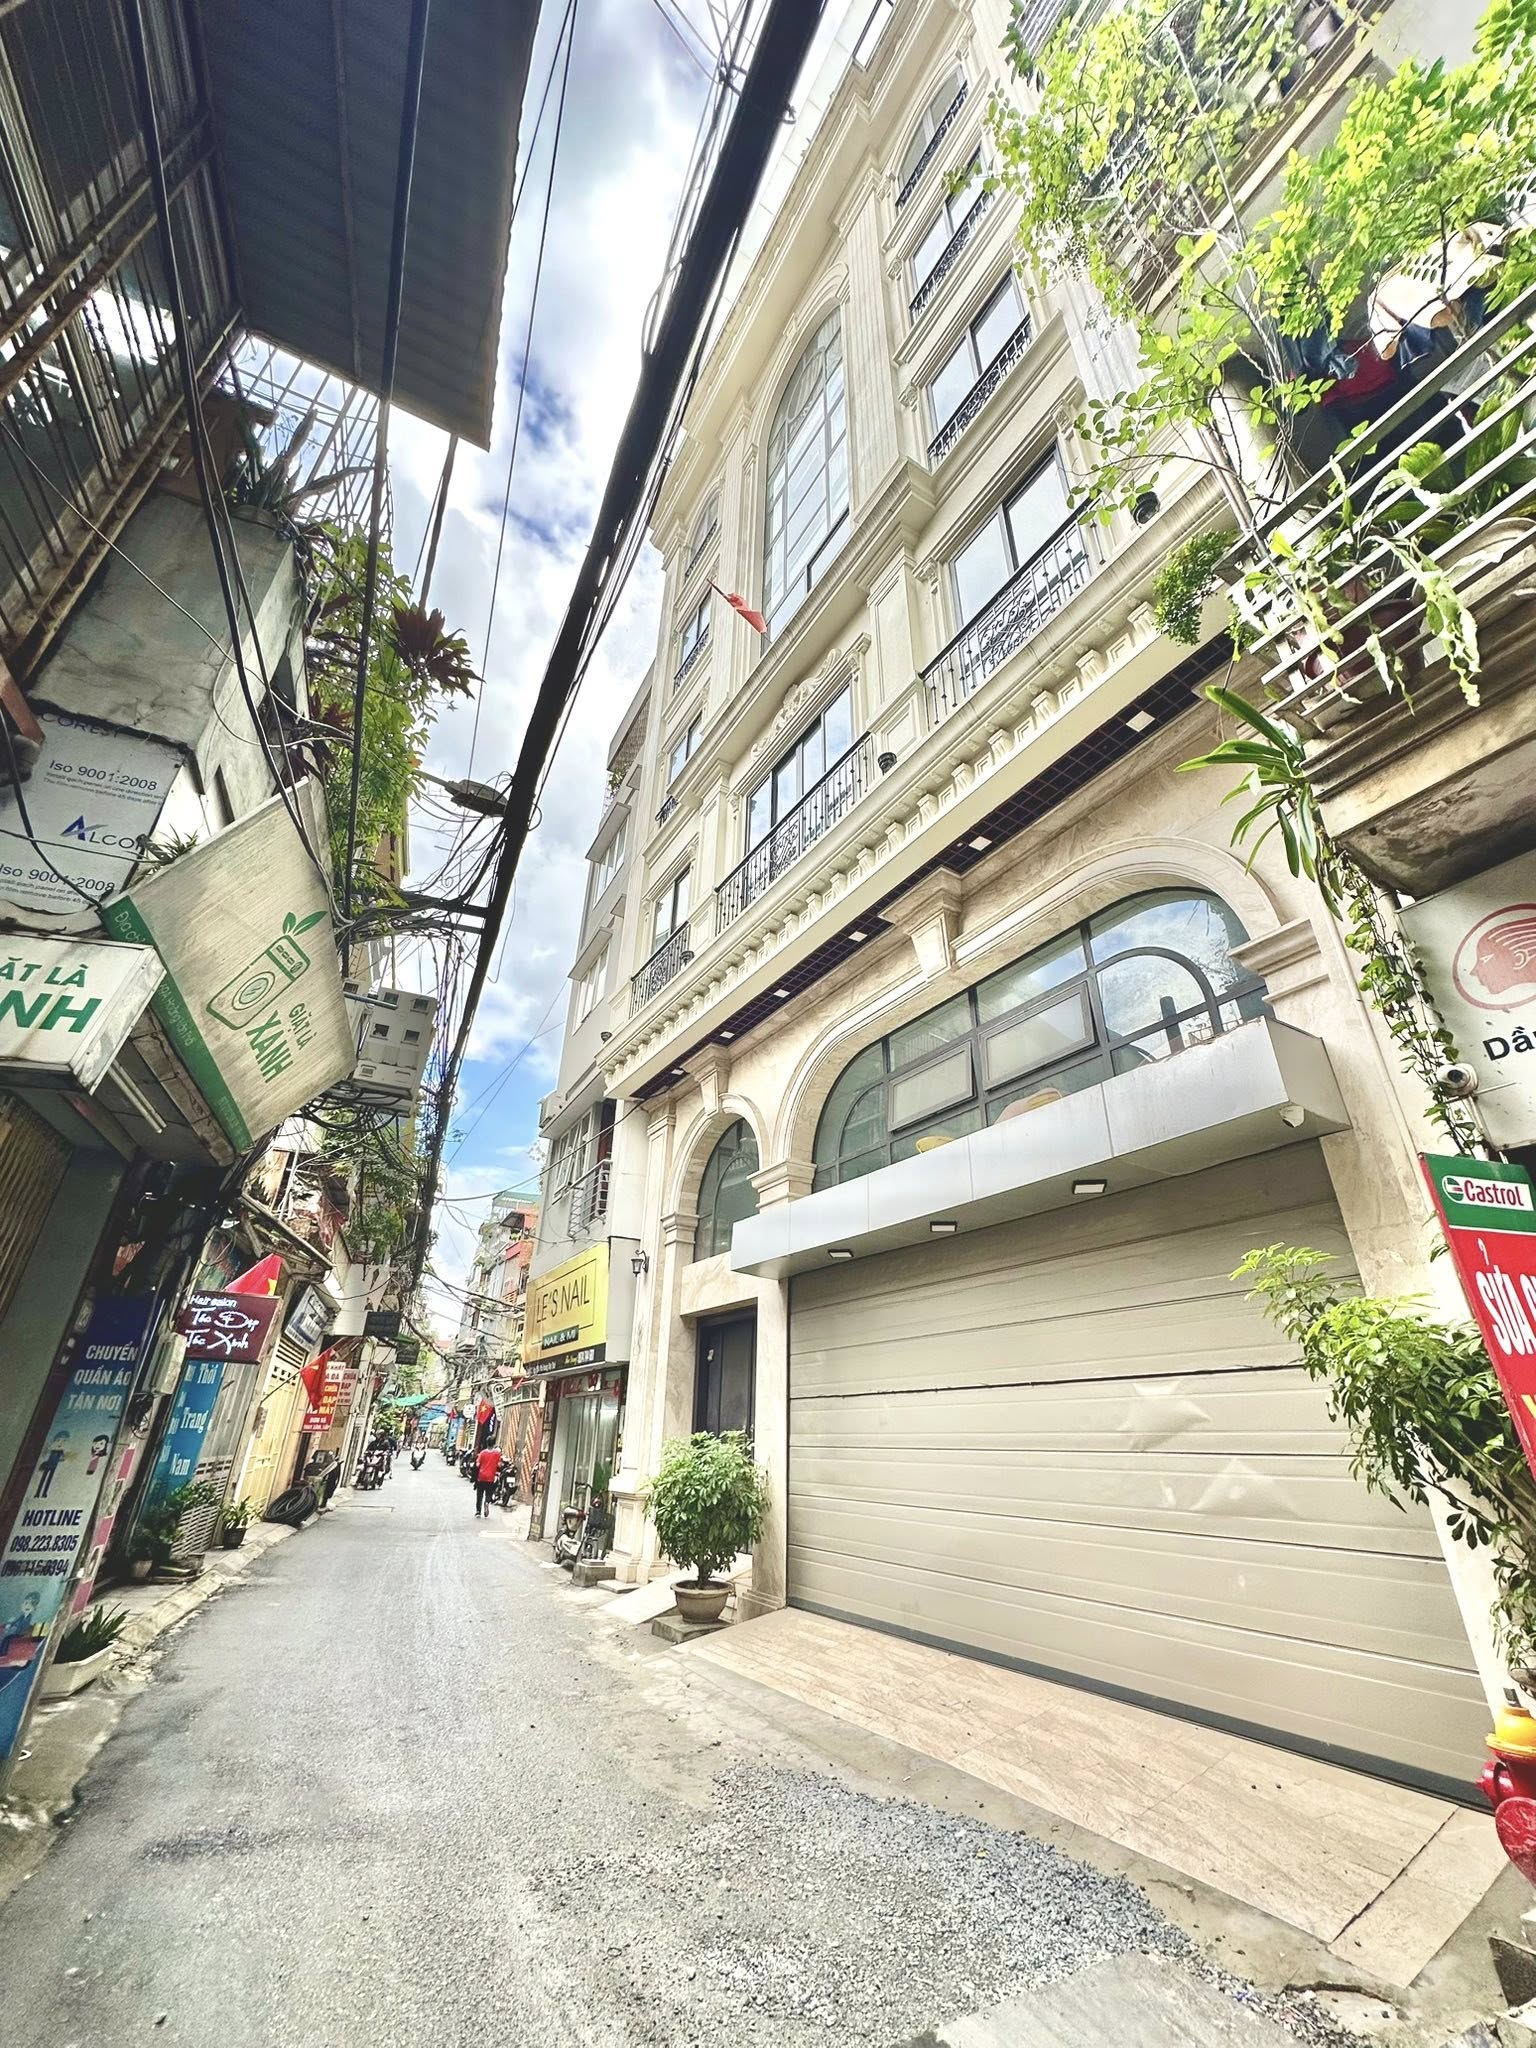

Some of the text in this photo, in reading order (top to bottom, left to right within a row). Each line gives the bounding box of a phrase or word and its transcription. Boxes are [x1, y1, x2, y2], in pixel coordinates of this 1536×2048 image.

[49, 760, 158, 791] Iso 9001:2008
[44, 964, 89, 988] LÀ
[246, 1010, 293, 1083] XANH
[1483, 1025, 1536, 1061] Dầ
[1463, 1179, 1524, 1206] Castrol
[560, 1275, 590, 1314] NAIL
[112, 1367, 132, 1386] ÁO
[180, 1407, 209, 1434] Trang
[22, 1509, 83, 1527] HOTLINE
[10, 1534, 79, 1552] 098.223.8305
